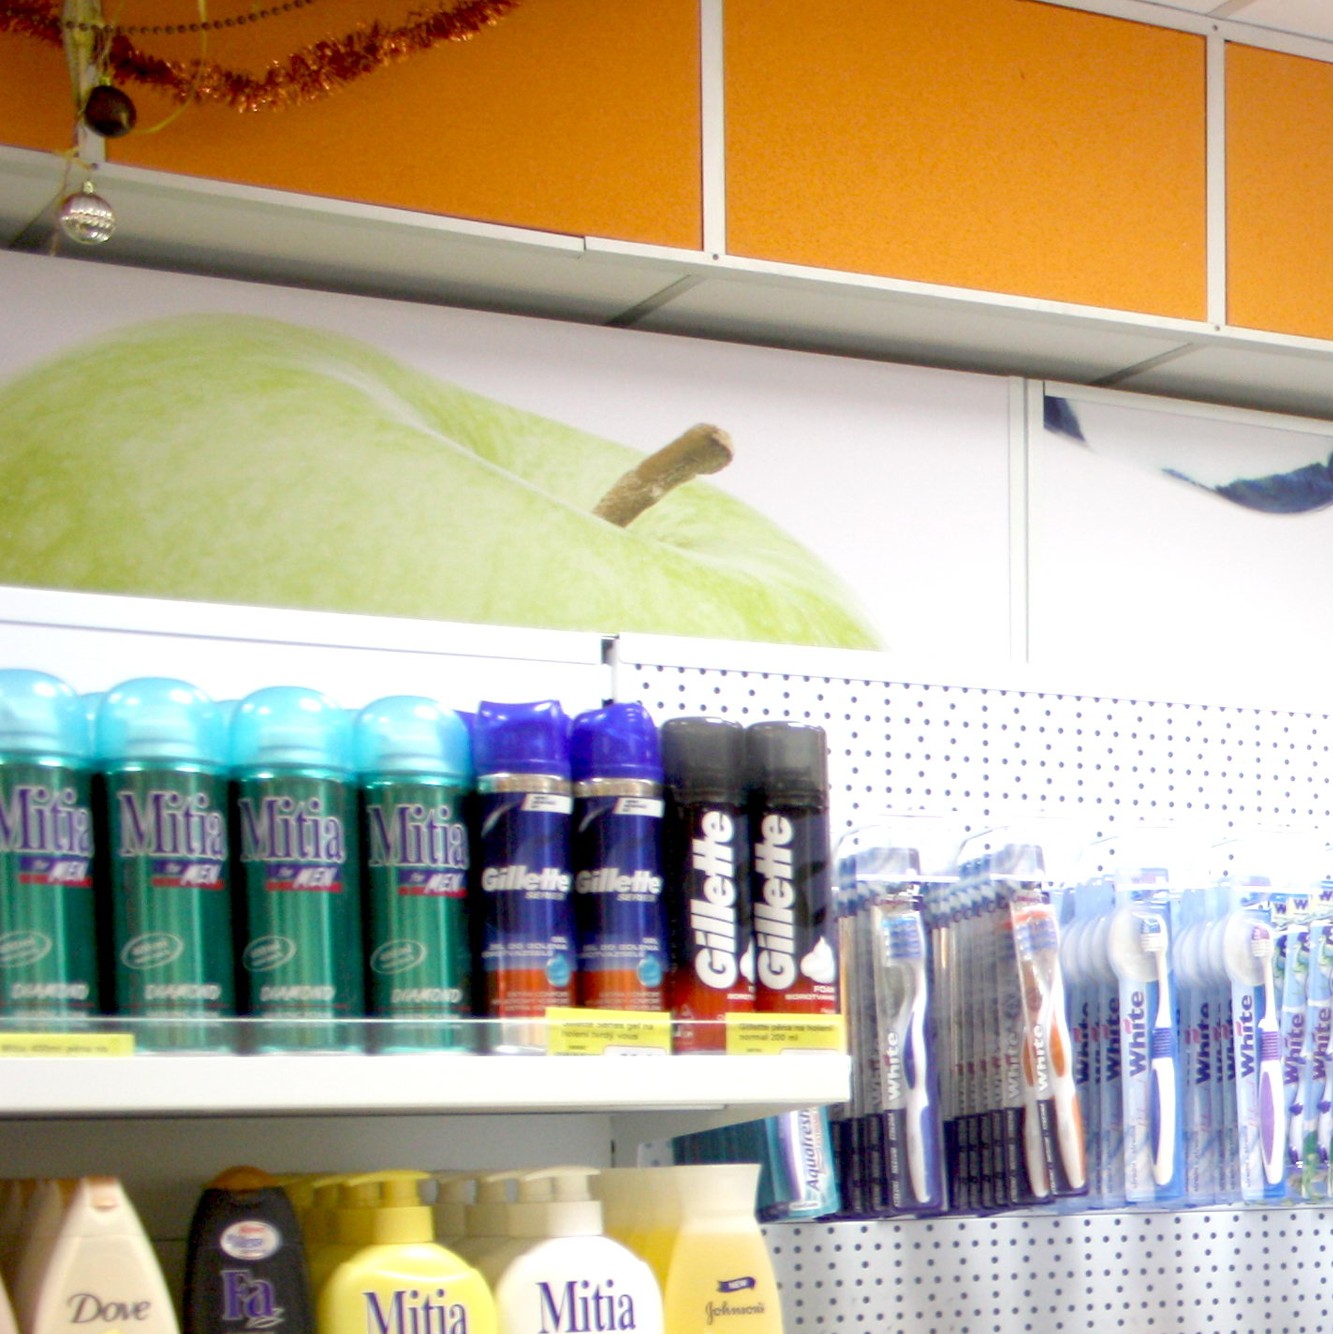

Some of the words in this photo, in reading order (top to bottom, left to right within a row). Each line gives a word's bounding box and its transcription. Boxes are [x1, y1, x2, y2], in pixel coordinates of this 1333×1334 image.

[118, 790, 228, 862] Mitia
[238, 797, 346, 865] Mitia
[368, 803, 470, 869] Mitia
[482, 864, 571, 893] Gillette
[575, 868, 663, 895] Gillette
[691, 811, 738, 990] Gillette
[754, 814, 797, 990] Gillette
[887, 1031, 902, 1102] White
[1034, 1022, 1050, 1093] White
[1127, 990, 1147, 1077] White
[1239, 993, 1255, 1079] White
[66, 1291, 151, 1324] Dove
[221, 1269, 275, 1321] Fa
[535, 1279, 637, 1334] Mitia
